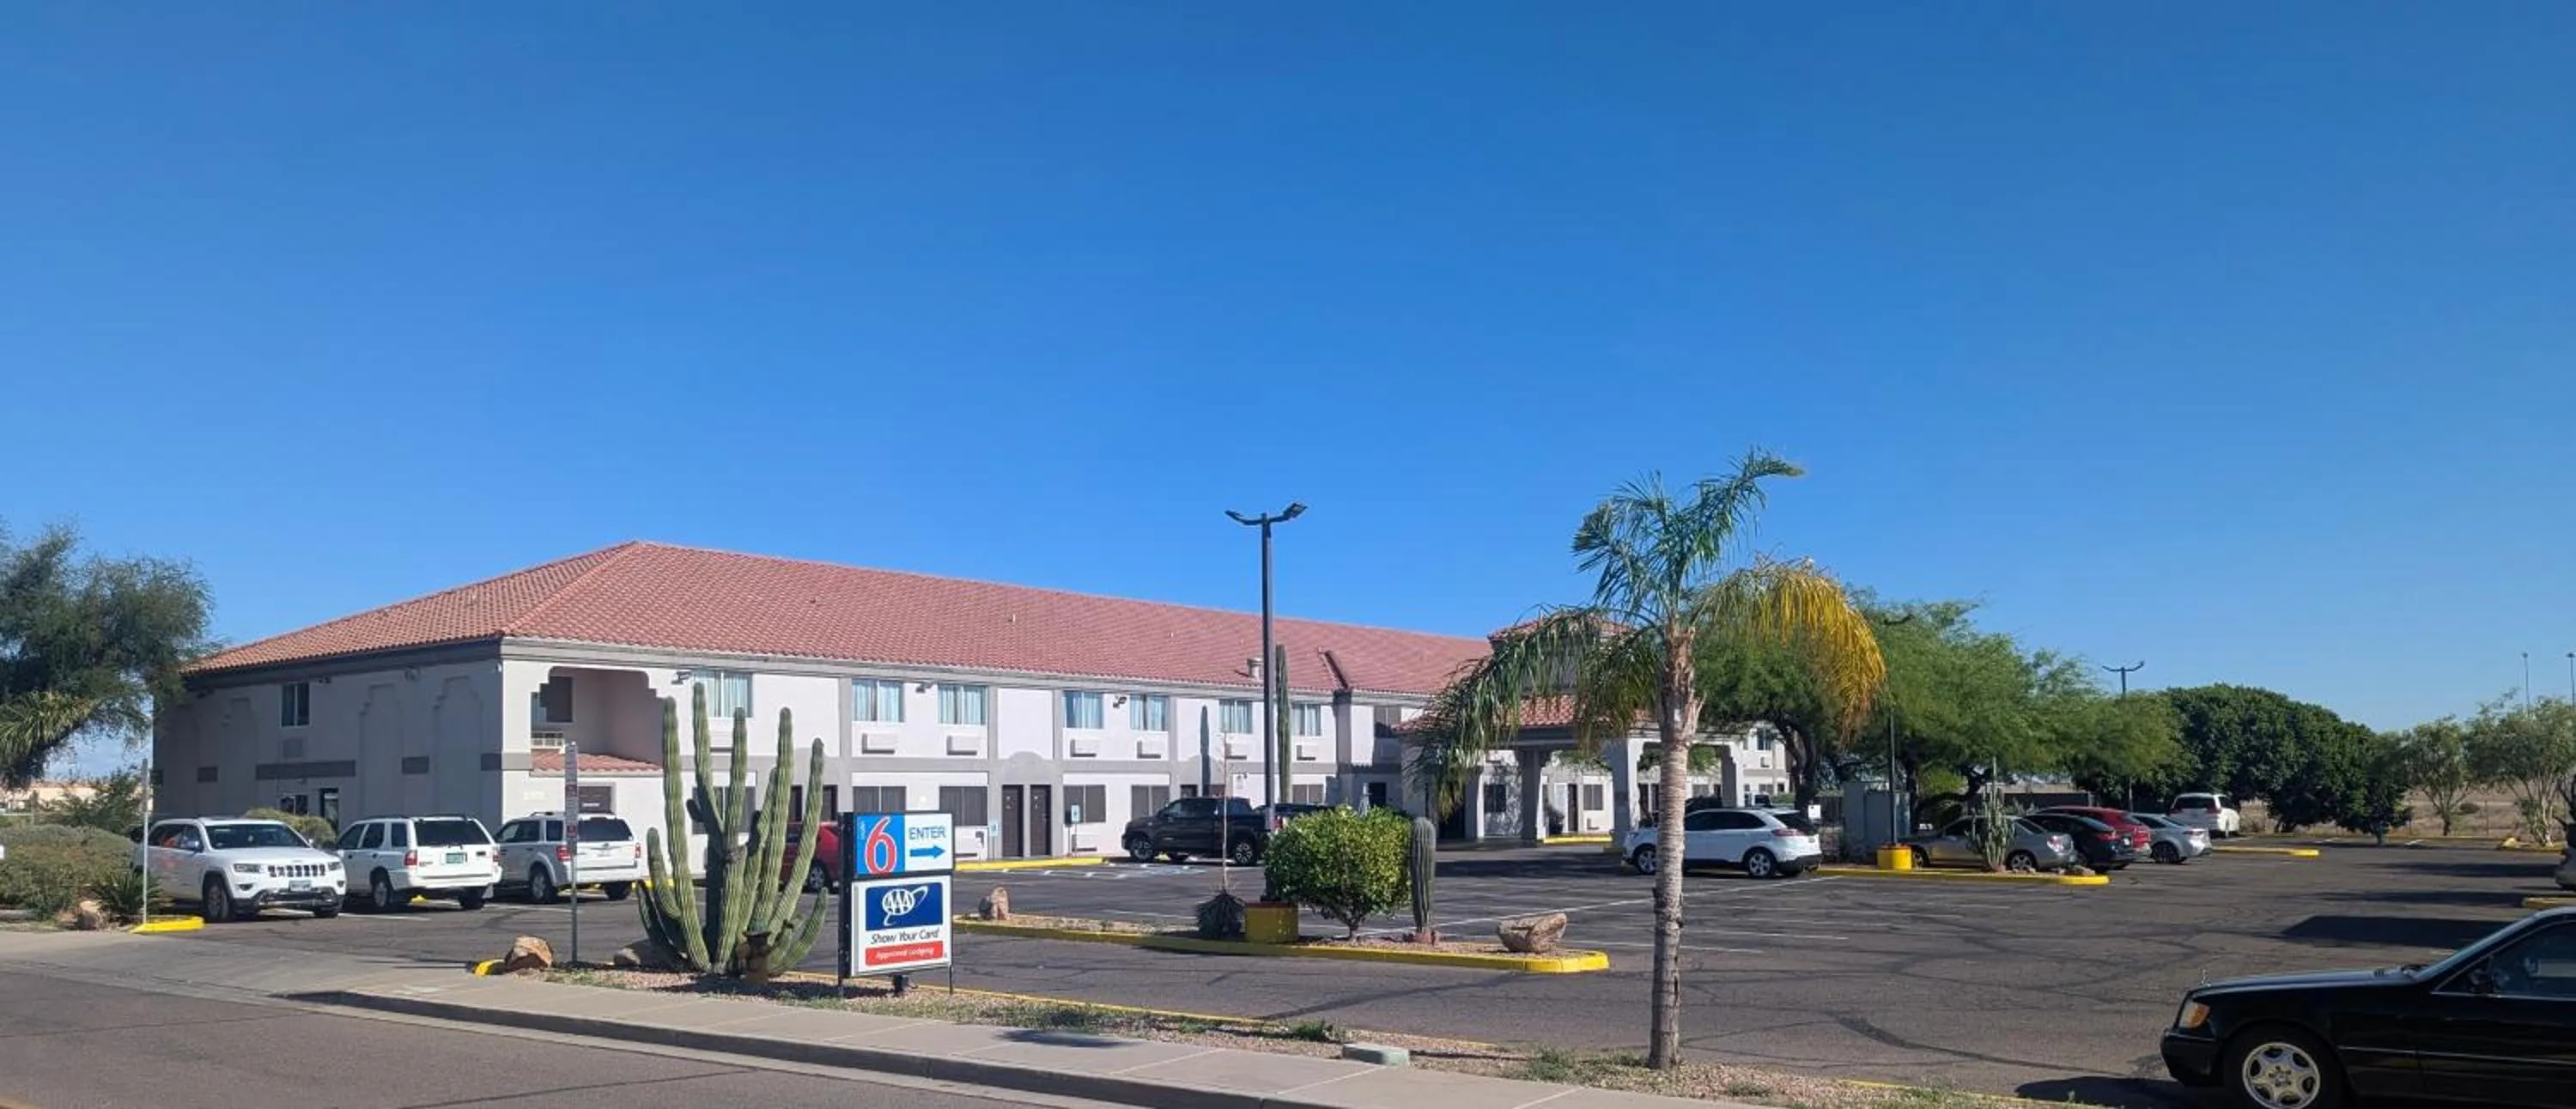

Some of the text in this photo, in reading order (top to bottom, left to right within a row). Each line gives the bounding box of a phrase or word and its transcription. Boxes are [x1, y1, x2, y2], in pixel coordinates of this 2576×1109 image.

[908, 826, 947, 839] ENTER
[865, 815, 897, 876] 6
[884, 890, 914, 913] AAA
[871, 927, 940, 945] Show Your Card
